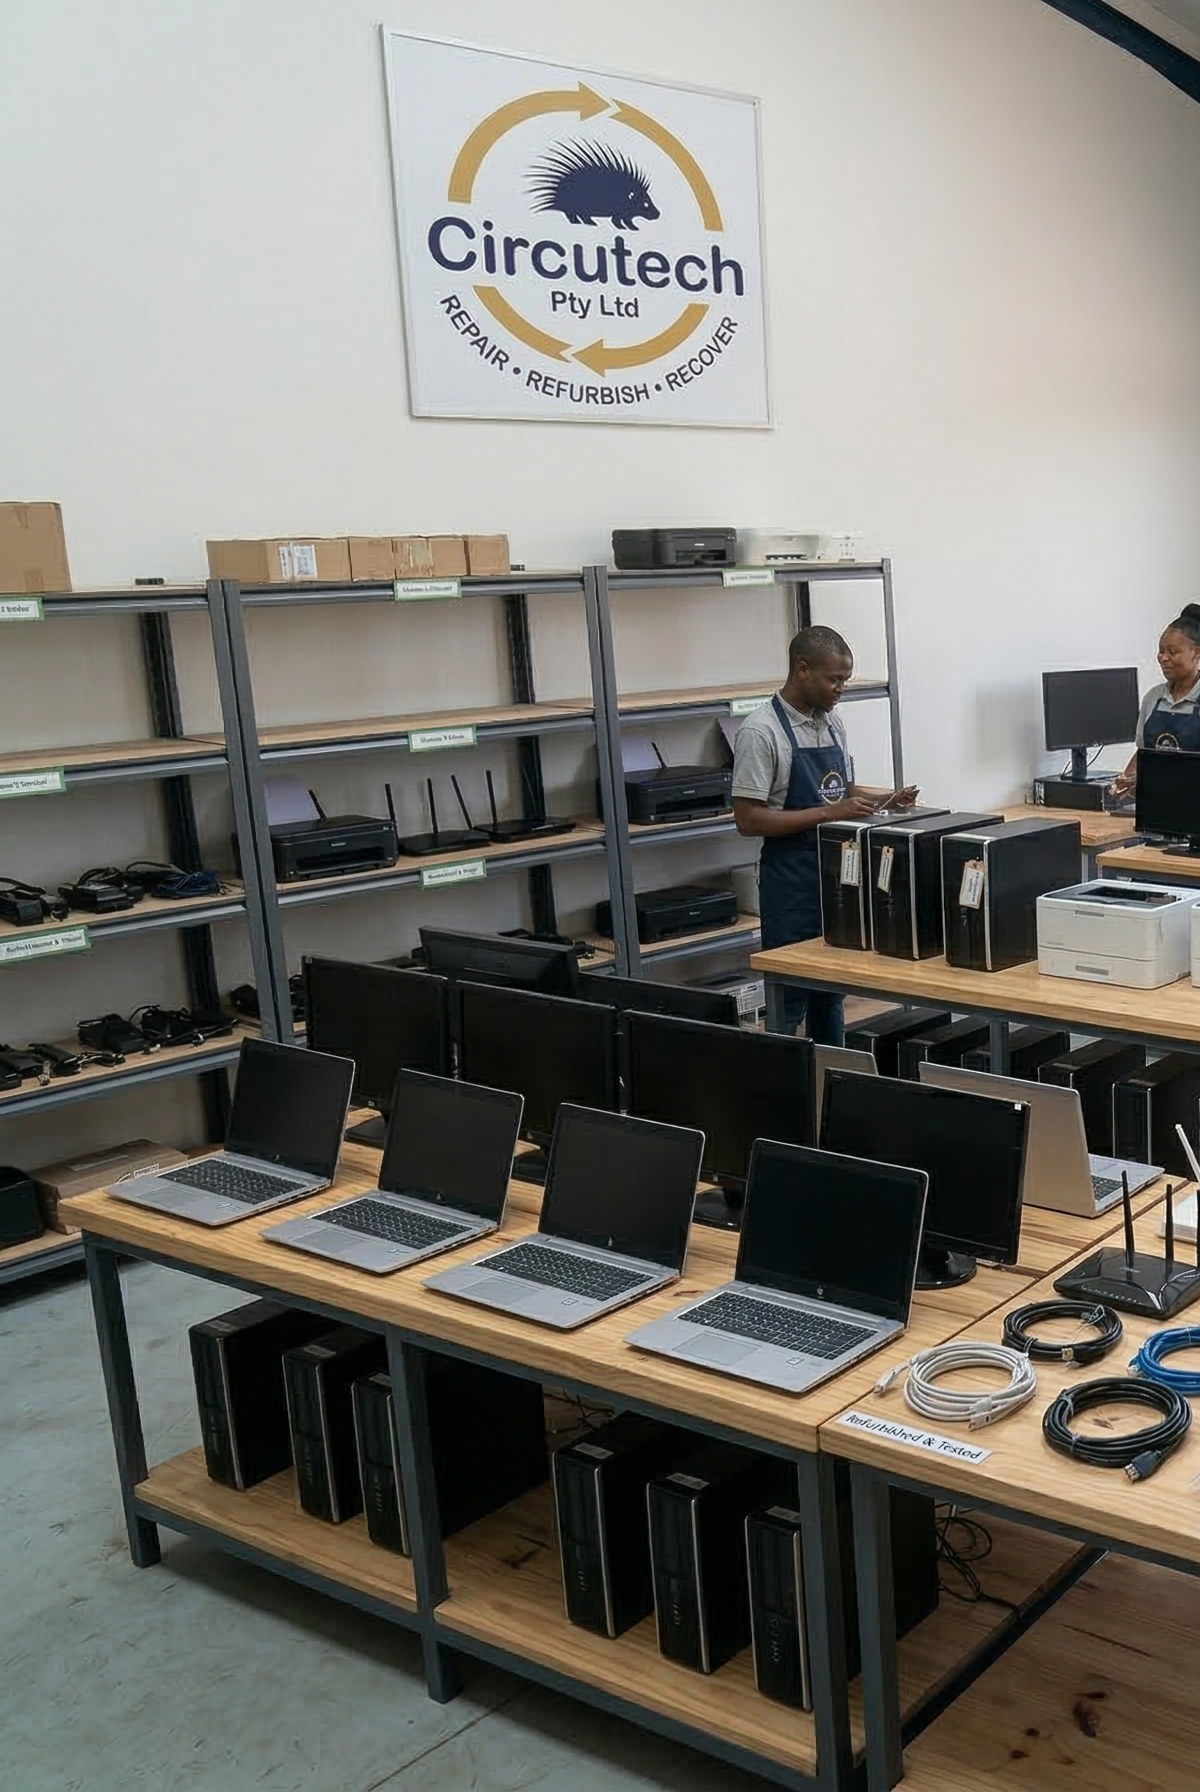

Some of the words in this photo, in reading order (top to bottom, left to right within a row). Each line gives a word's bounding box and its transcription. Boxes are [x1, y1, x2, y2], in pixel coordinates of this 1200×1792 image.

[427, 216, 744, 296] Circutech
[551, 291, 591, 319] Pty
[600, 294, 639, 318] Ltd
[440, 294, 510, 371] REPAIR
[526, 370, 651, 405] REFURBISH
[664, 316, 738, 391] RECOVER
